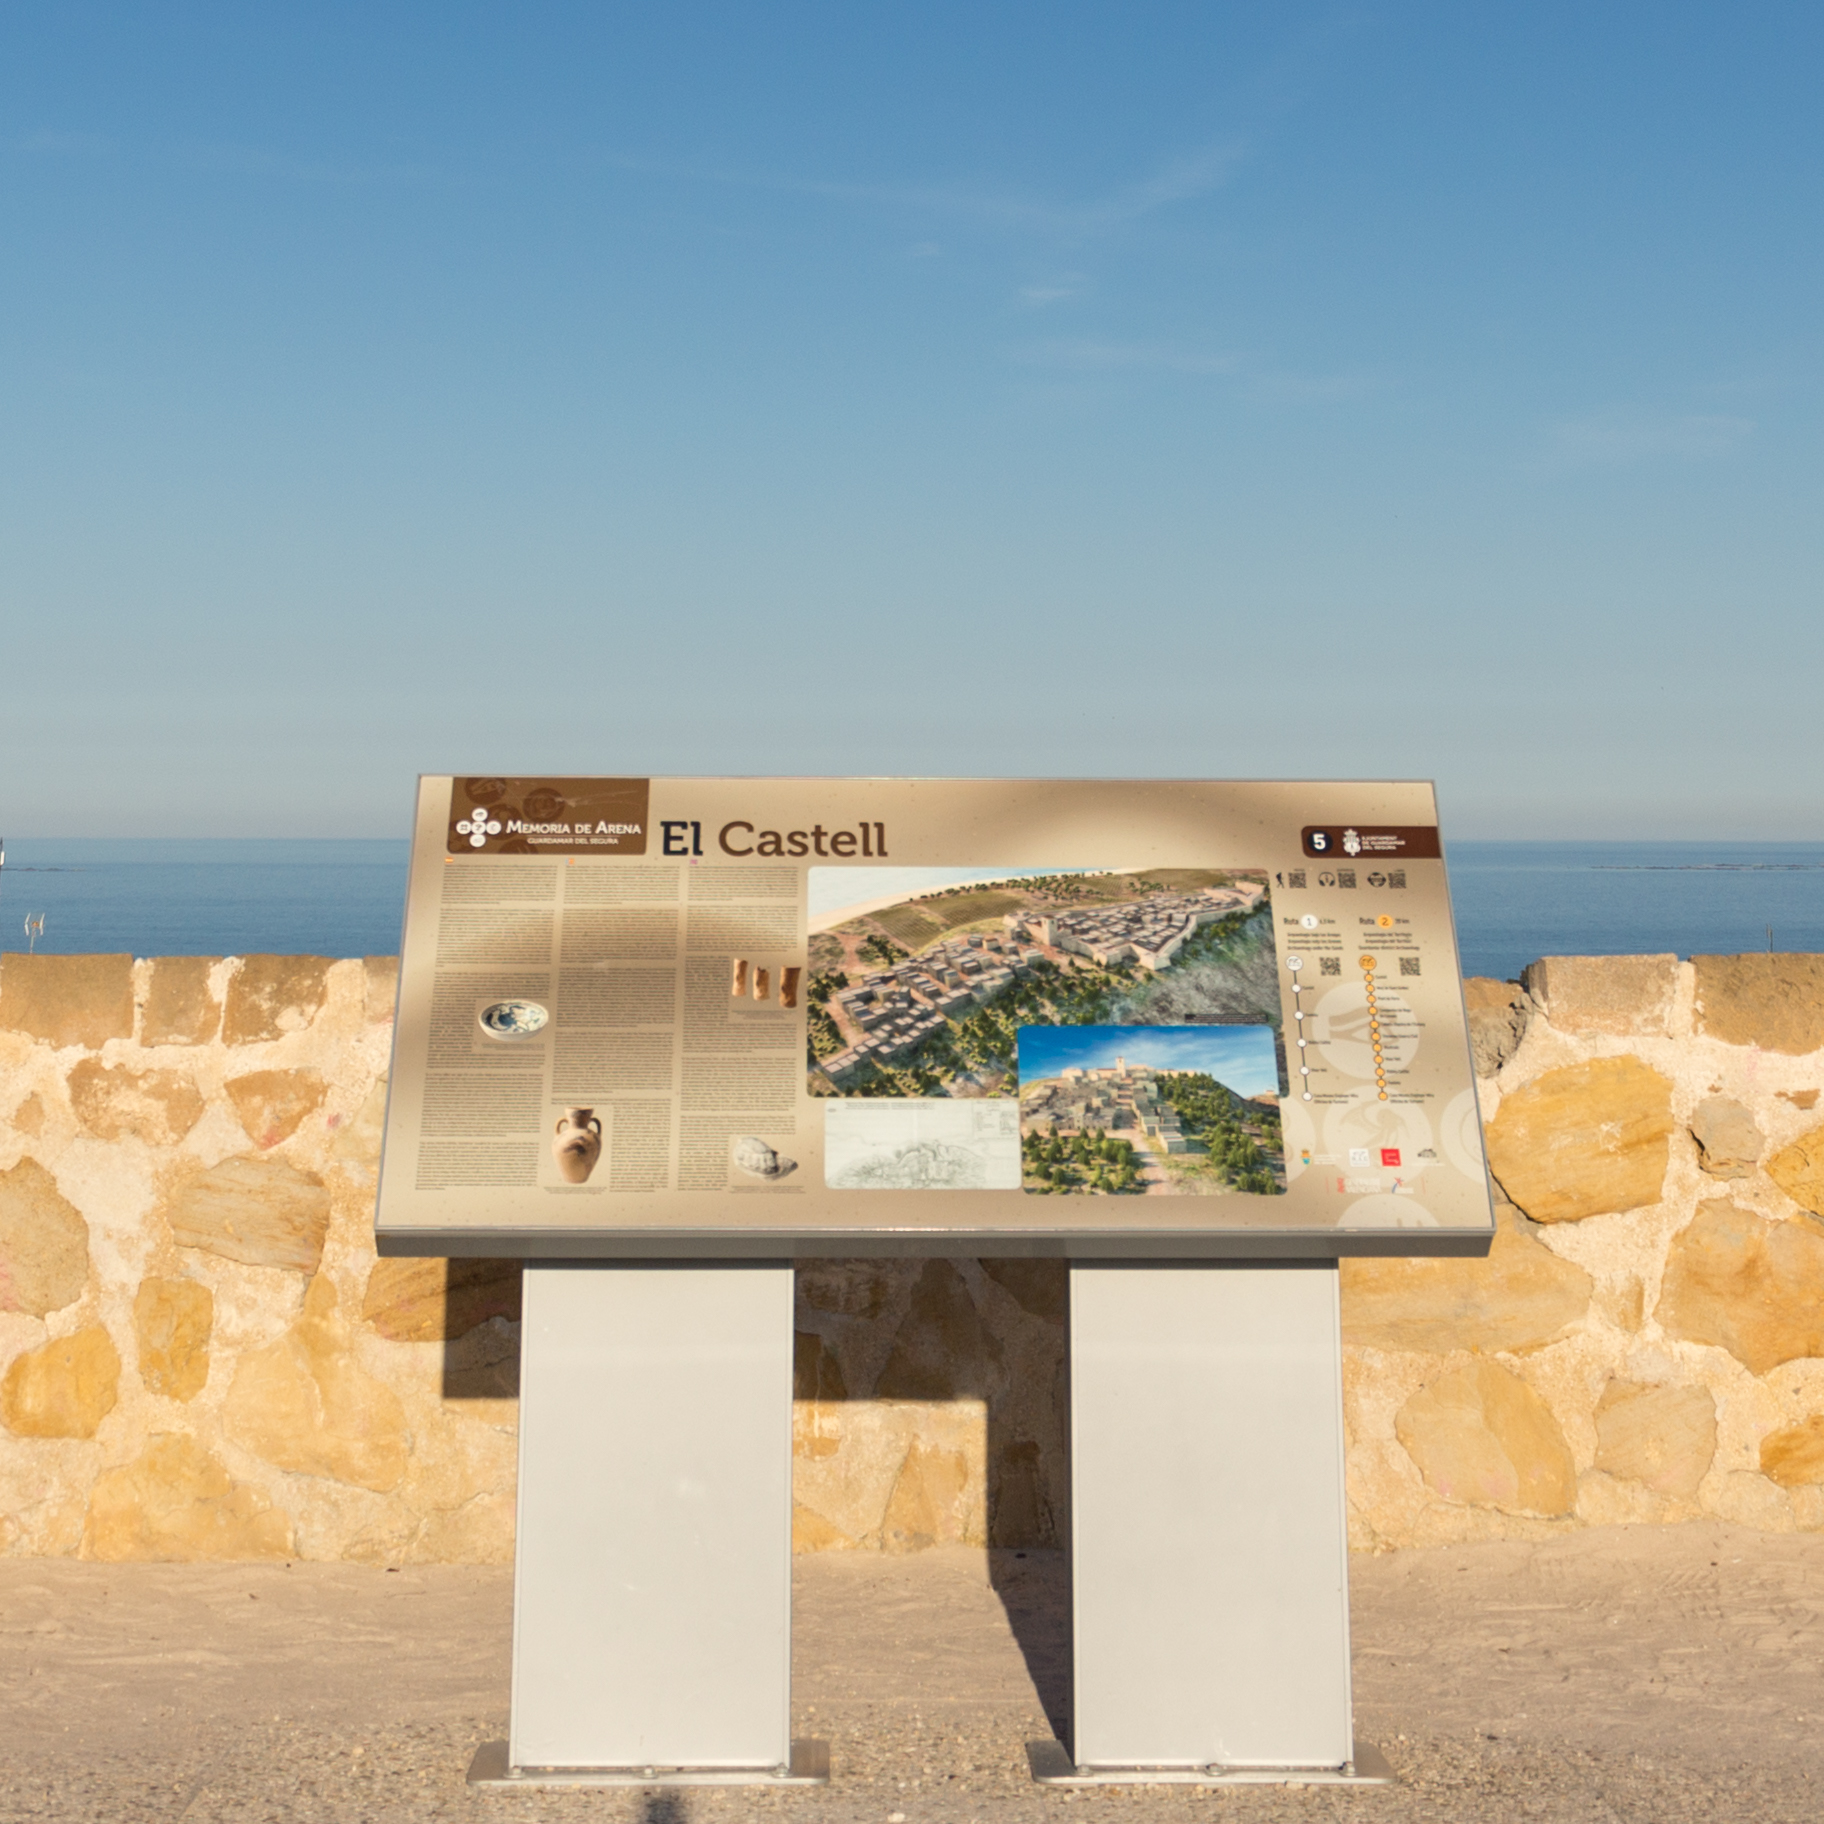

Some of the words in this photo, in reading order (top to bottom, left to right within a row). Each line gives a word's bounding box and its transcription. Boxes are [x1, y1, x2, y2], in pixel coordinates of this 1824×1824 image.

[506, 819, 570, 834] MEMORIA
[574, 823, 591, 834] DE
[595, 820, 642, 834] ARENA
[527, 837, 573, 845] GUARDAMAR
[575, 837, 588, 845] DEL
[589, 837, 619, 845] SEGURA
[660, 820, 703, 856] El
[718, 820, 888, 857] Castell
[1312, 833, 1326, 850] 5
[1381, 917, 1389, 926] 2
